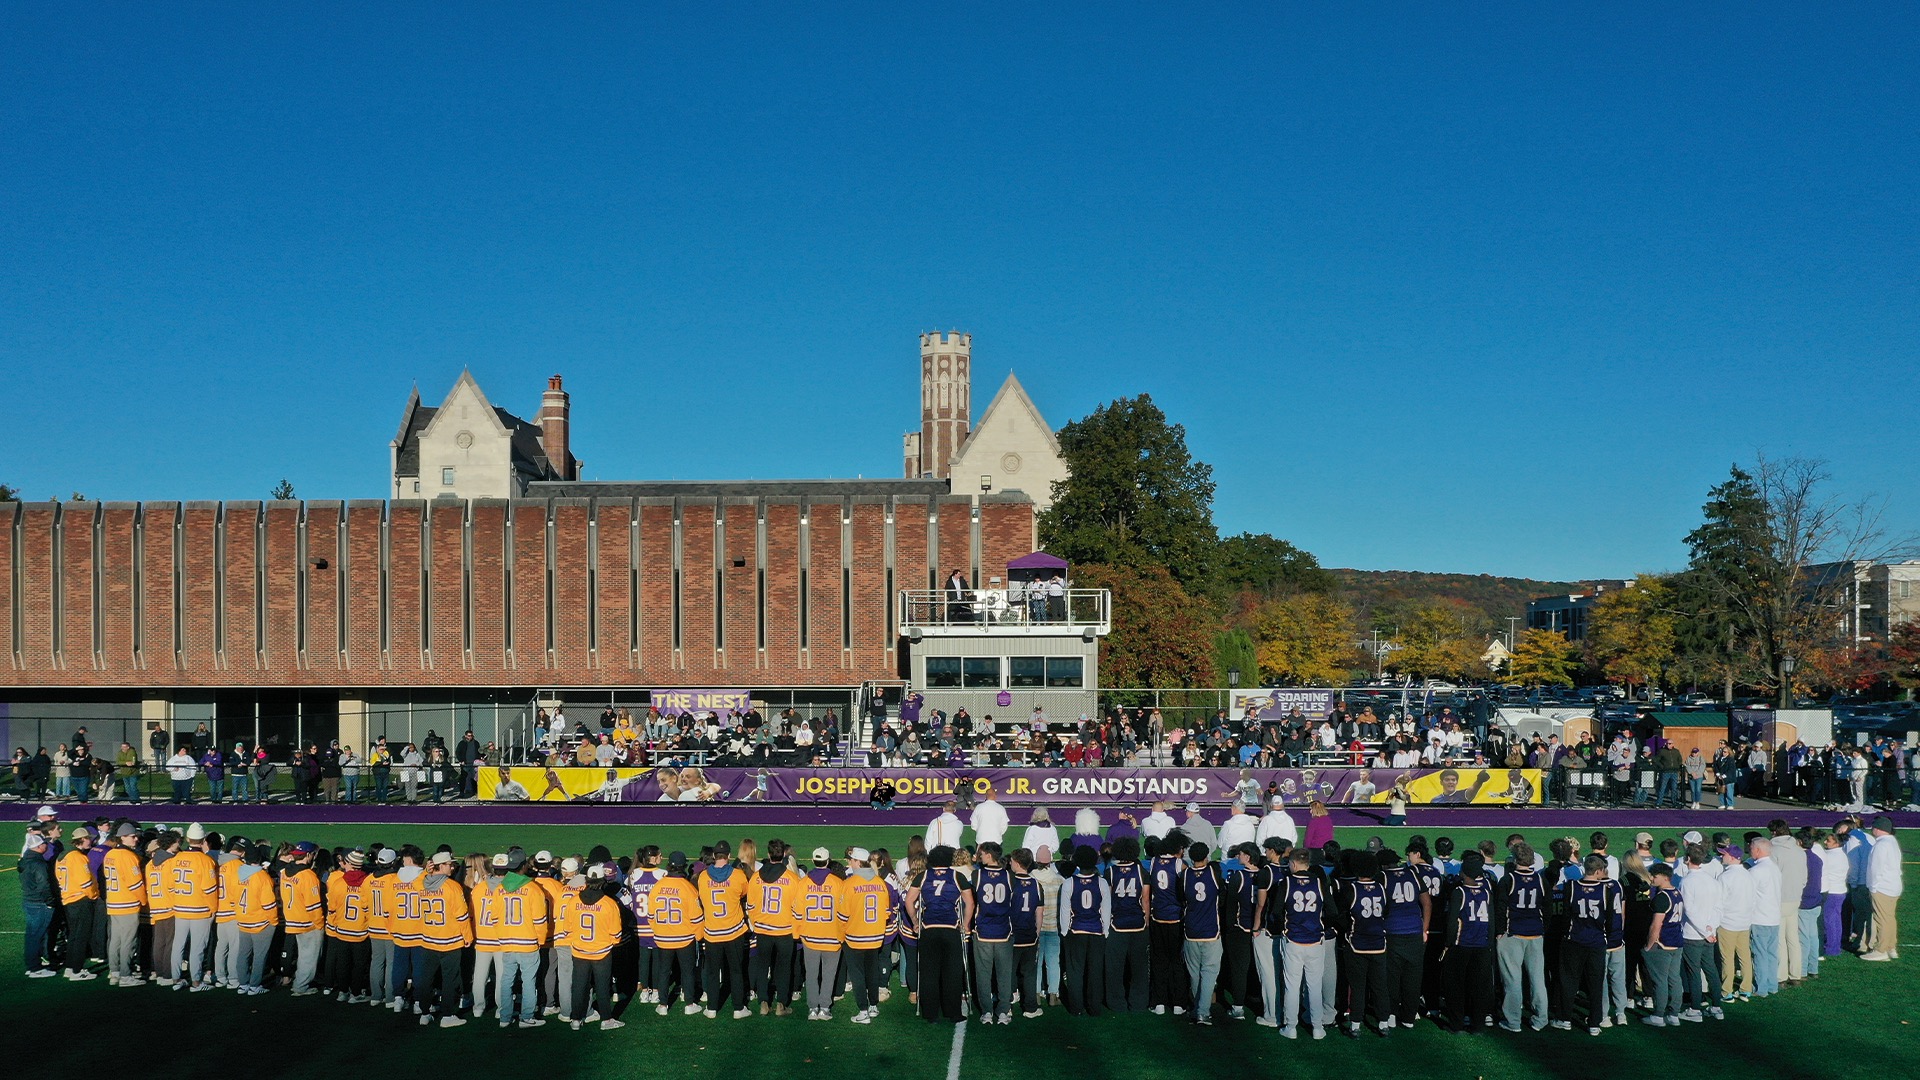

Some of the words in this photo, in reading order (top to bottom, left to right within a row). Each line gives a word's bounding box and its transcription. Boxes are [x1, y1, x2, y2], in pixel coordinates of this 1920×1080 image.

[653, 694, 691, 708] THE
[698, 694, 748, 708] NEST
[1277, 692, 1329, 702] SOARING
[1281, 702, 1325, 711] EAGLES
[796, 777, 875, 794] JOSEPH
[882, 777, 998, 794] OSILLO
[1006, 777, 1037, 794] JR.
[1042, 777, 1208, 794] GRANDSTANDS
[150, 872, 163, 898] 2
[932, 879, 946, 897] 7
[1115, 877, 1137, 898] 44
[1156, 869, 1168, 890] 9
[239, 888, 248, 914] 4
[761, 885, 783, 914] 18
[982, 883, 1006, 904] 30
[1021, 891, 1030, 912] 1
[1081, 889, 1093, 909] 0
[1194, 881, 1206, 902] 3
[1293, 890, 1317, 912] 32
[1392, 881, 1415, 904] 40
[1516, 887, 1537, 909] 11
[345, 894, 360, 921] 6
[372, 889, 383, 917] 11
[396, 892, 420, 919] 30
[421, 898, 445, 926] 23
[503, 896, 523, 926] 10
[656, 895, 683, 924] 26
[711, 889, 727, 917] 5
[806, 893, 834, 923] 29
[863, 894, 878, 923] 8
[1361, 896, 1383, 918] 35
[1468, 899, 1489, 922] 14
[1577, 898, 1600, 920] 15
[580, 912, 596, 943] 9
